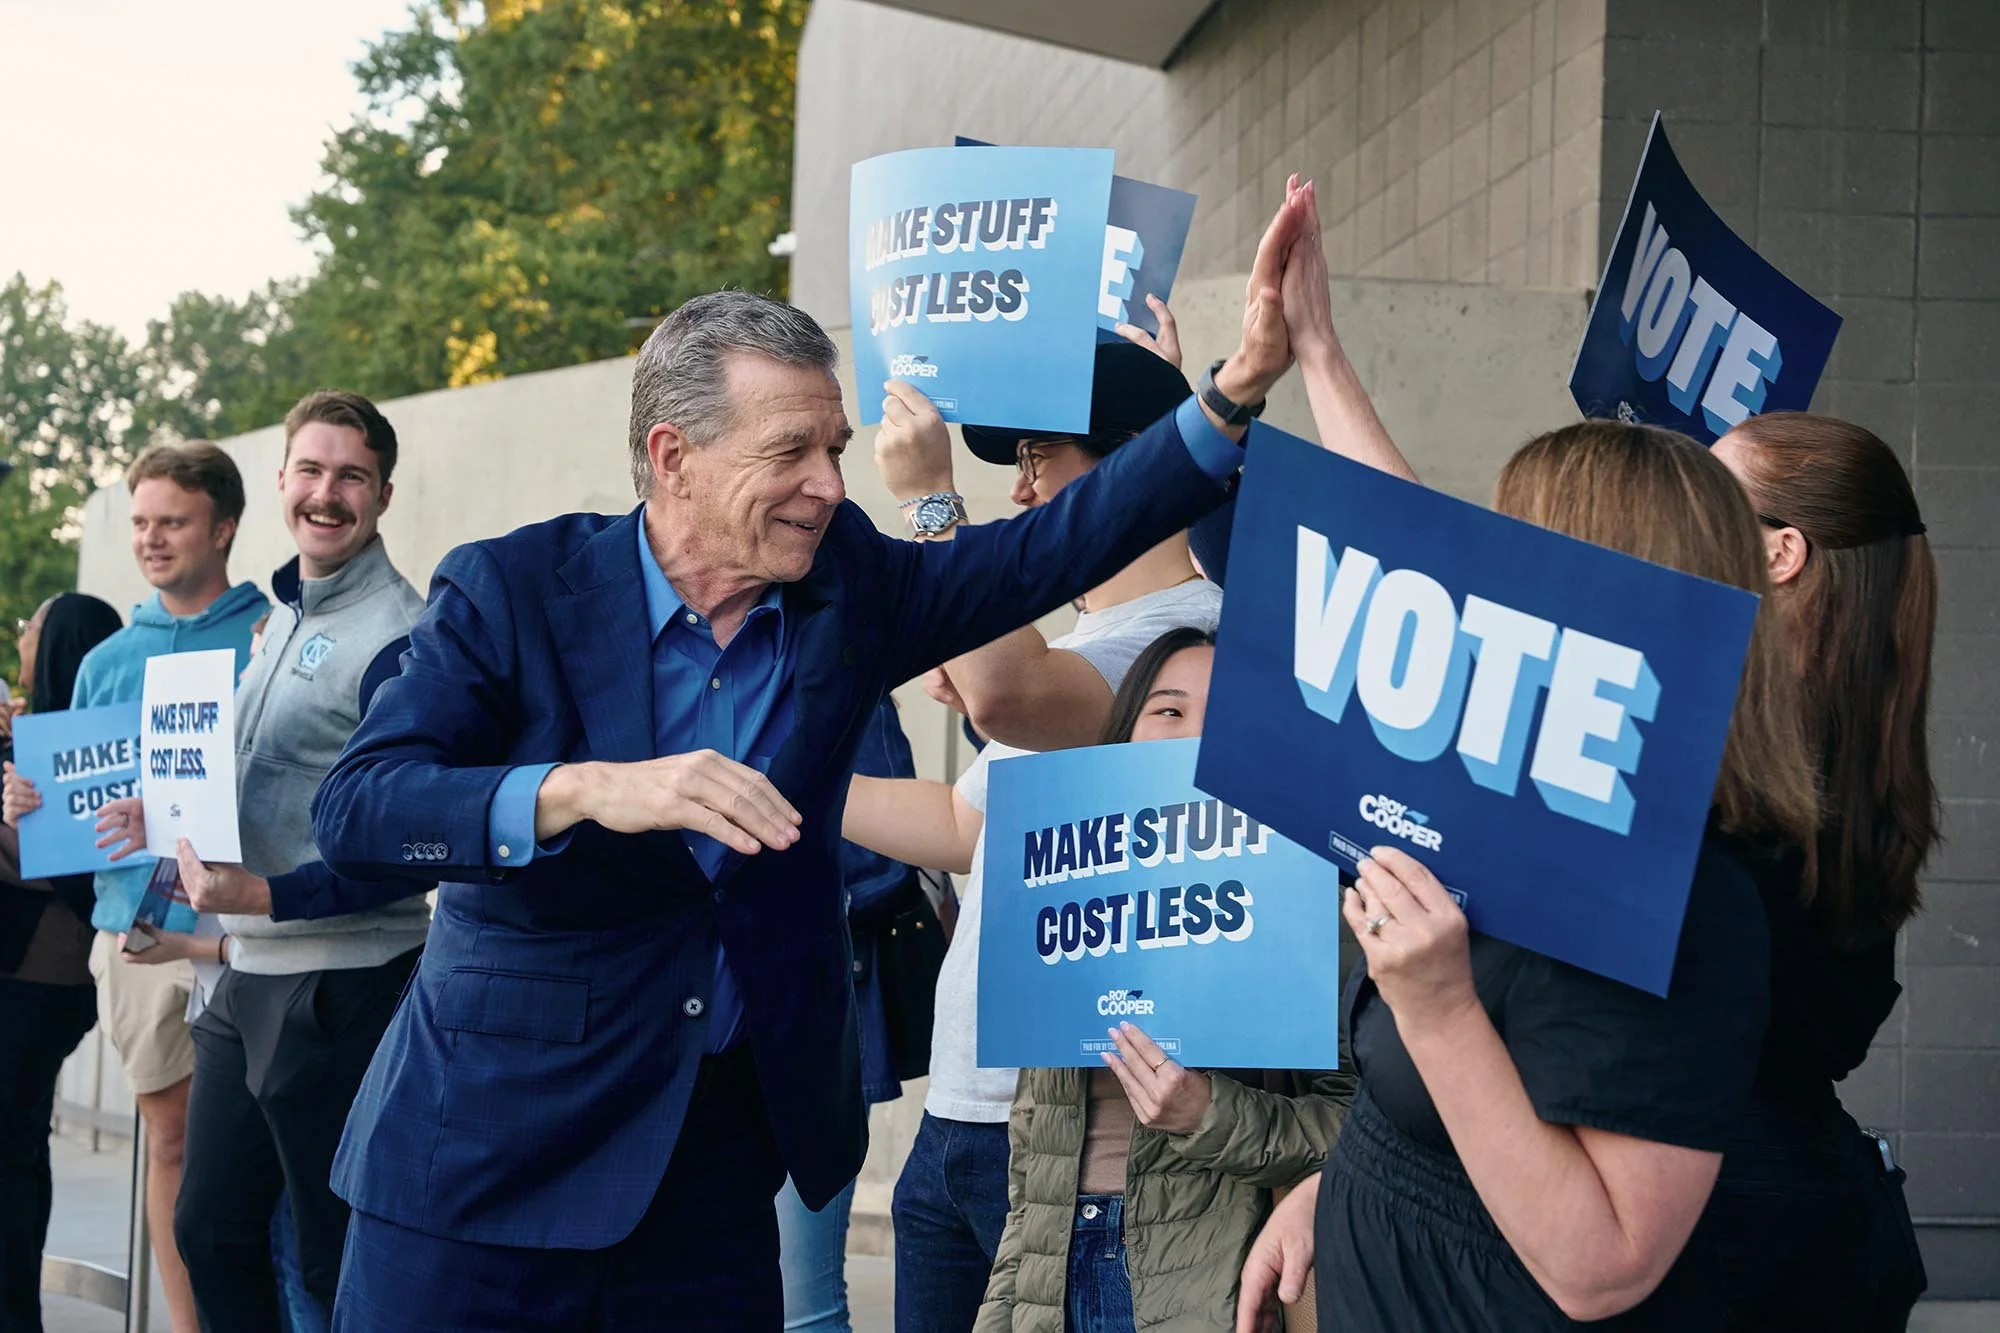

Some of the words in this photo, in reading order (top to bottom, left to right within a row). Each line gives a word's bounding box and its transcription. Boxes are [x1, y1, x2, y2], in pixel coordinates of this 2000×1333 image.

[931, 197, 1057, 254] STUFF
[926, 268, 1030, 323] LESS
[1619, 200, 1783, 438] VOTE
[1294, 524, 1662, 837] VOTE
[151, 703, 177, 734] MAKE
[178, 702, 219, 734] STUFF
[52, 737, 135, 783] MAKE
[150, 749, 173, 780] COST
[174, 748, 207, 780] LESS.
[1359, 794, 1443, 852] COOPER
[1378, 794, 1409, 818] ROY
[1024, 812, 1129, 888] MAKE
[1036, 893, 1135, 965] COST
[1136, 879, 1254, 950] LESS
[1097, 995, 1155, 1016] COOPER
[1109, 990, 1129, 1001] ROY
